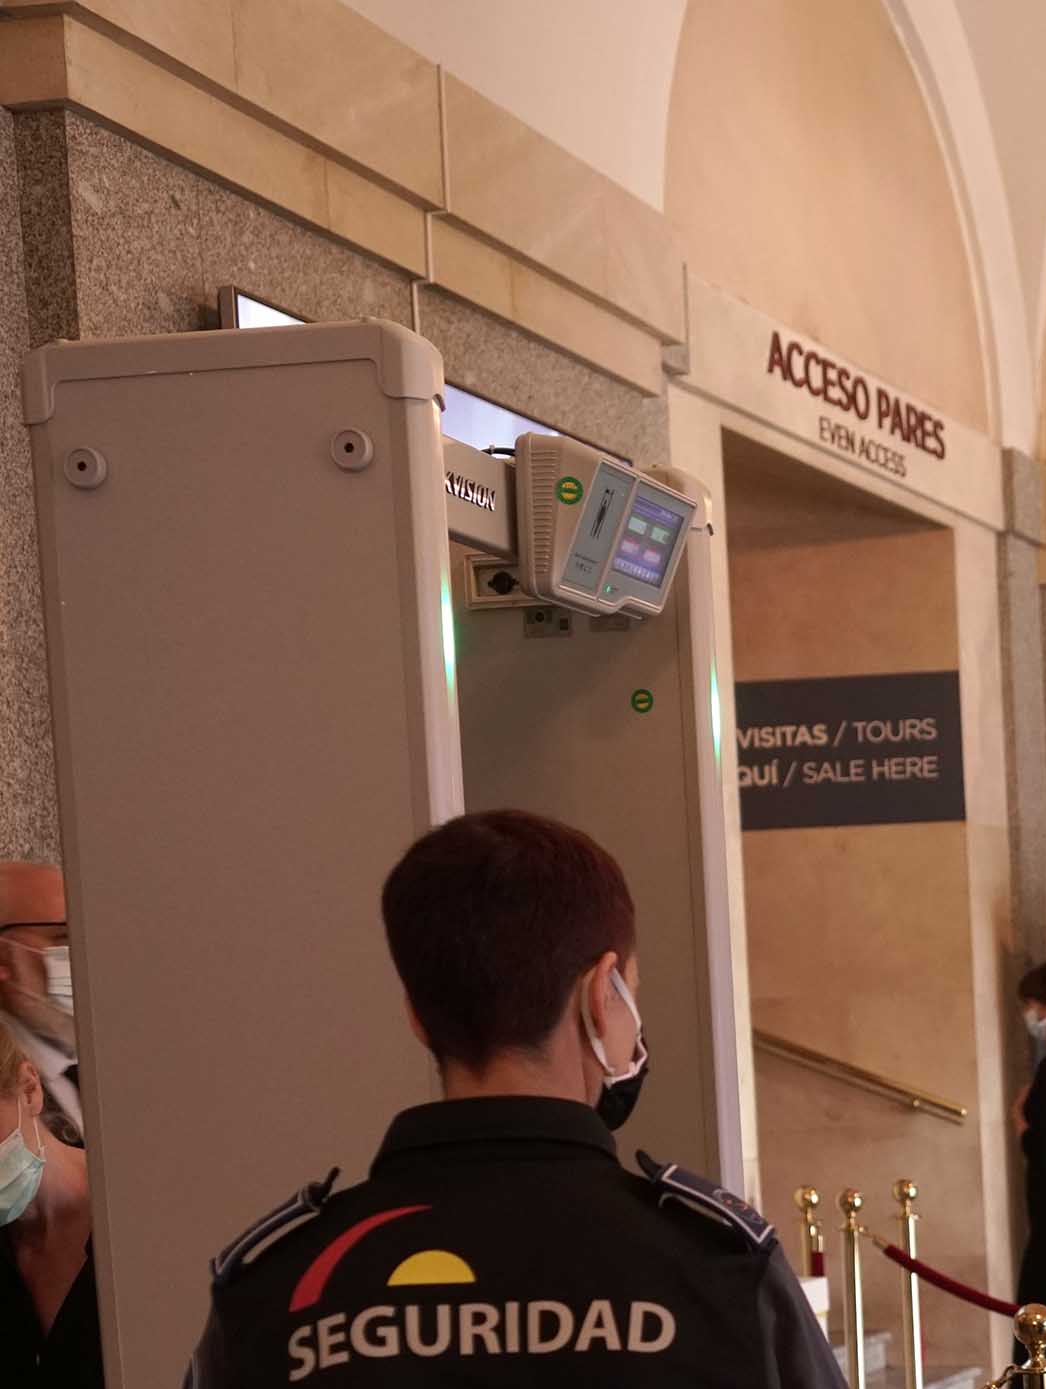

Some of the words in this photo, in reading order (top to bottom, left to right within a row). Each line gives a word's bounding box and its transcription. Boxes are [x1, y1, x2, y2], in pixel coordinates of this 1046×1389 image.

[768, 331, 870, 421] ACCESO
[876, 387, 946, 460] PARES
[819, 416, 856, 454] EVEN
[858, 436, 908, 478] ACCESS
[736, 723, 829, 749] VISITAS
[852, 718, 938, 744] TOURS
[802, 759, 866, 784] SALE
[871, 755, 939, 780] HERE
[288, 1299, 677, 1382] SEGURIDAD
